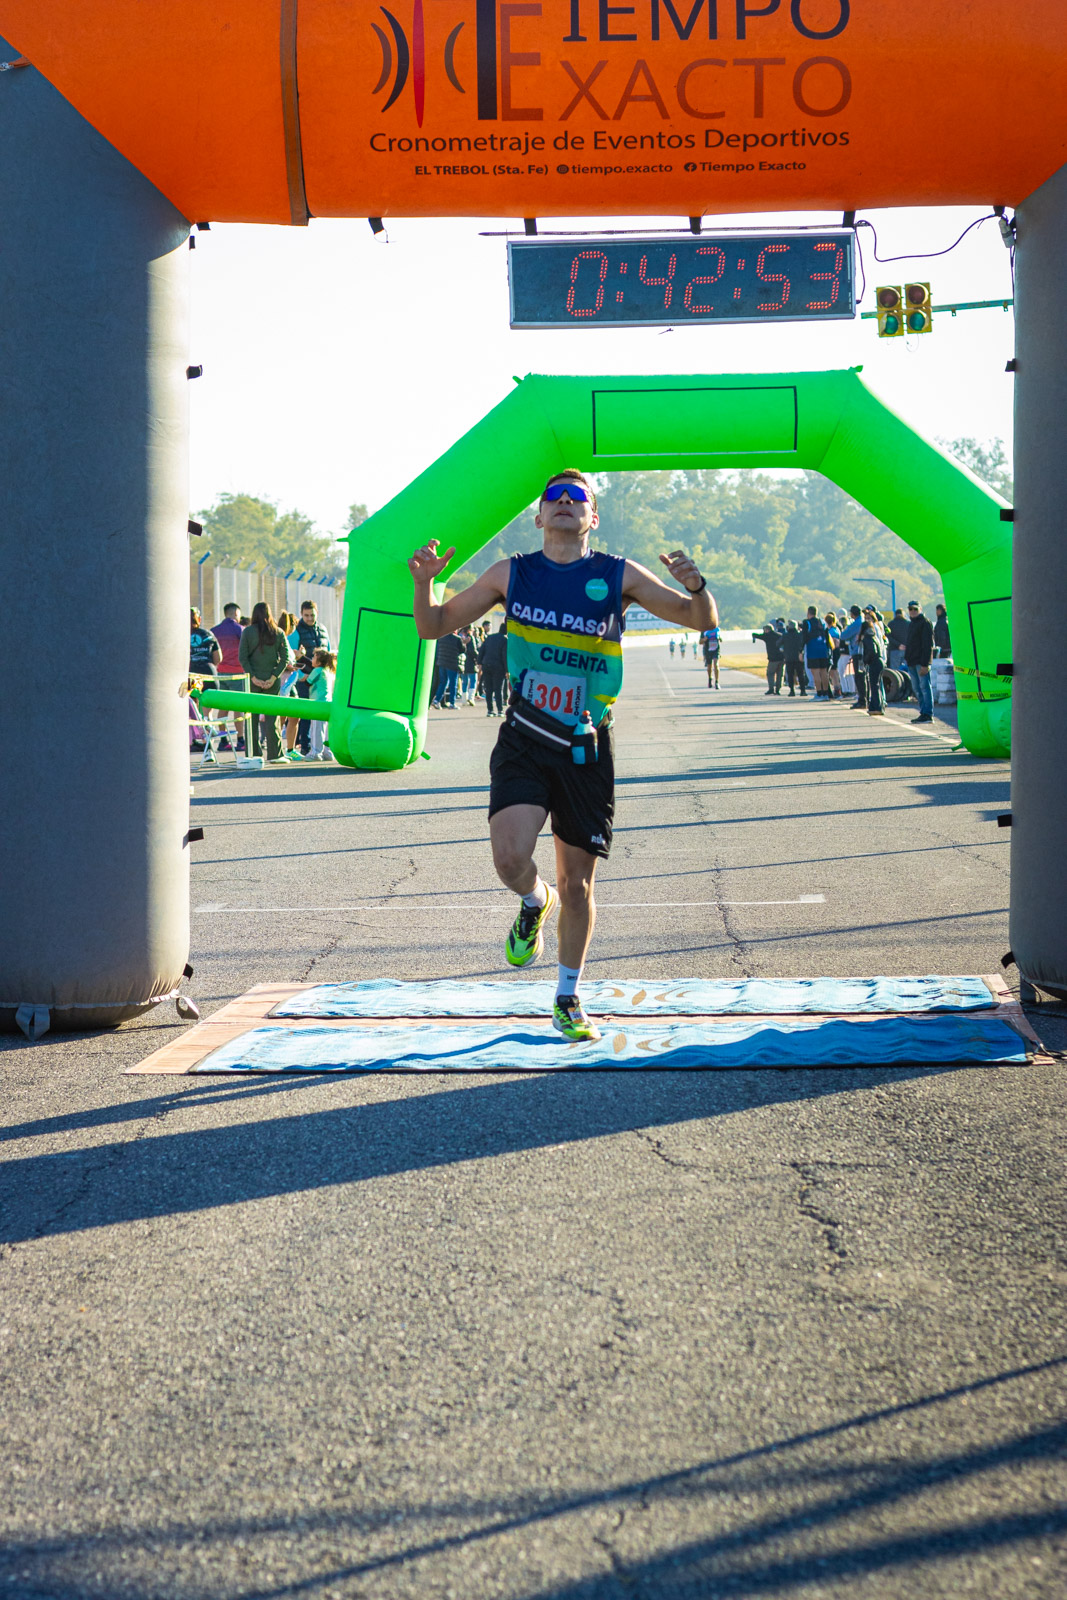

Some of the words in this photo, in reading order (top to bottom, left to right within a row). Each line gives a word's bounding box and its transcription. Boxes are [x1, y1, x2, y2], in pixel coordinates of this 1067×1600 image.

[369, 132, 545, 156] Cronometraje
[553, 130, 585, 150] de
[594, 130, 696, 150] Eventos
[704, 128, 850, 152] Deportivos
[415, 165, 431, 175] EL
[433, 165, 489, 175] TREBOL
[492, 164, 525, 176] (Sta.
[527, 164, 549, 175] Fe)
[571, 163, 674, 176] tiempo.exacto
[699, 161, 755, 173] Tiempo
[758, 161, 807, 171] Exacto
[565, 242, 843, 318] 0:42:53
[511, 602, 557, 627] CADA
[561, 613, 607, 636] PASO
[540, 646, 609, 675] CUENTA
[534, 683, 574, 714] 301
